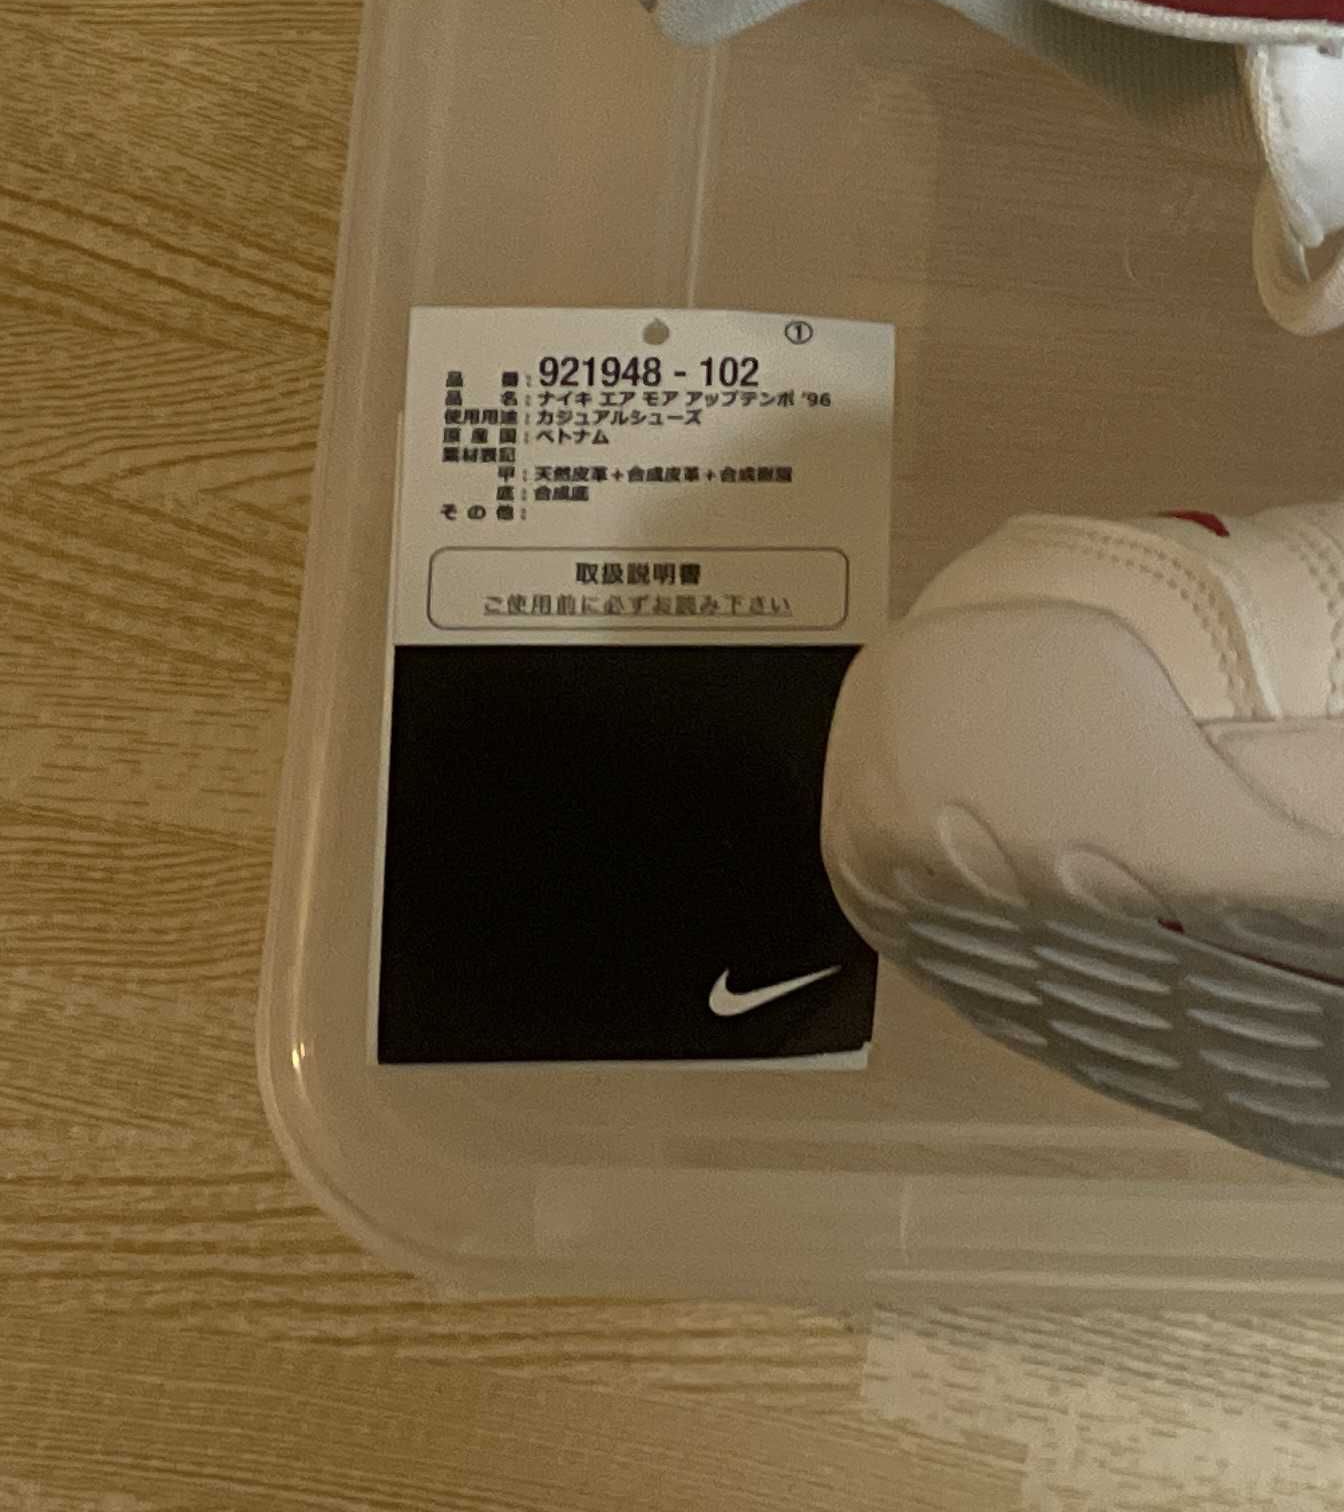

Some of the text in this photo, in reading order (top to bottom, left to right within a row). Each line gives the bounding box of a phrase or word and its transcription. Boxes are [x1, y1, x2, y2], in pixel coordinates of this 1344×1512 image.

[538, 357, 662, 387] 921948
[700, 357, 759, 387] 102
[537, 391, 593, 407] ナイキ
[601, 392, 635, 407] エア
[642, 392, 677, 407] モア
[686, 391, 795, 407] アップテンポ
[536, 409, 702, 425] カジュアルシューズ
[535, 429, 610, 444] ベトナム
[576, 563, 701, 584] 取扱説明書
